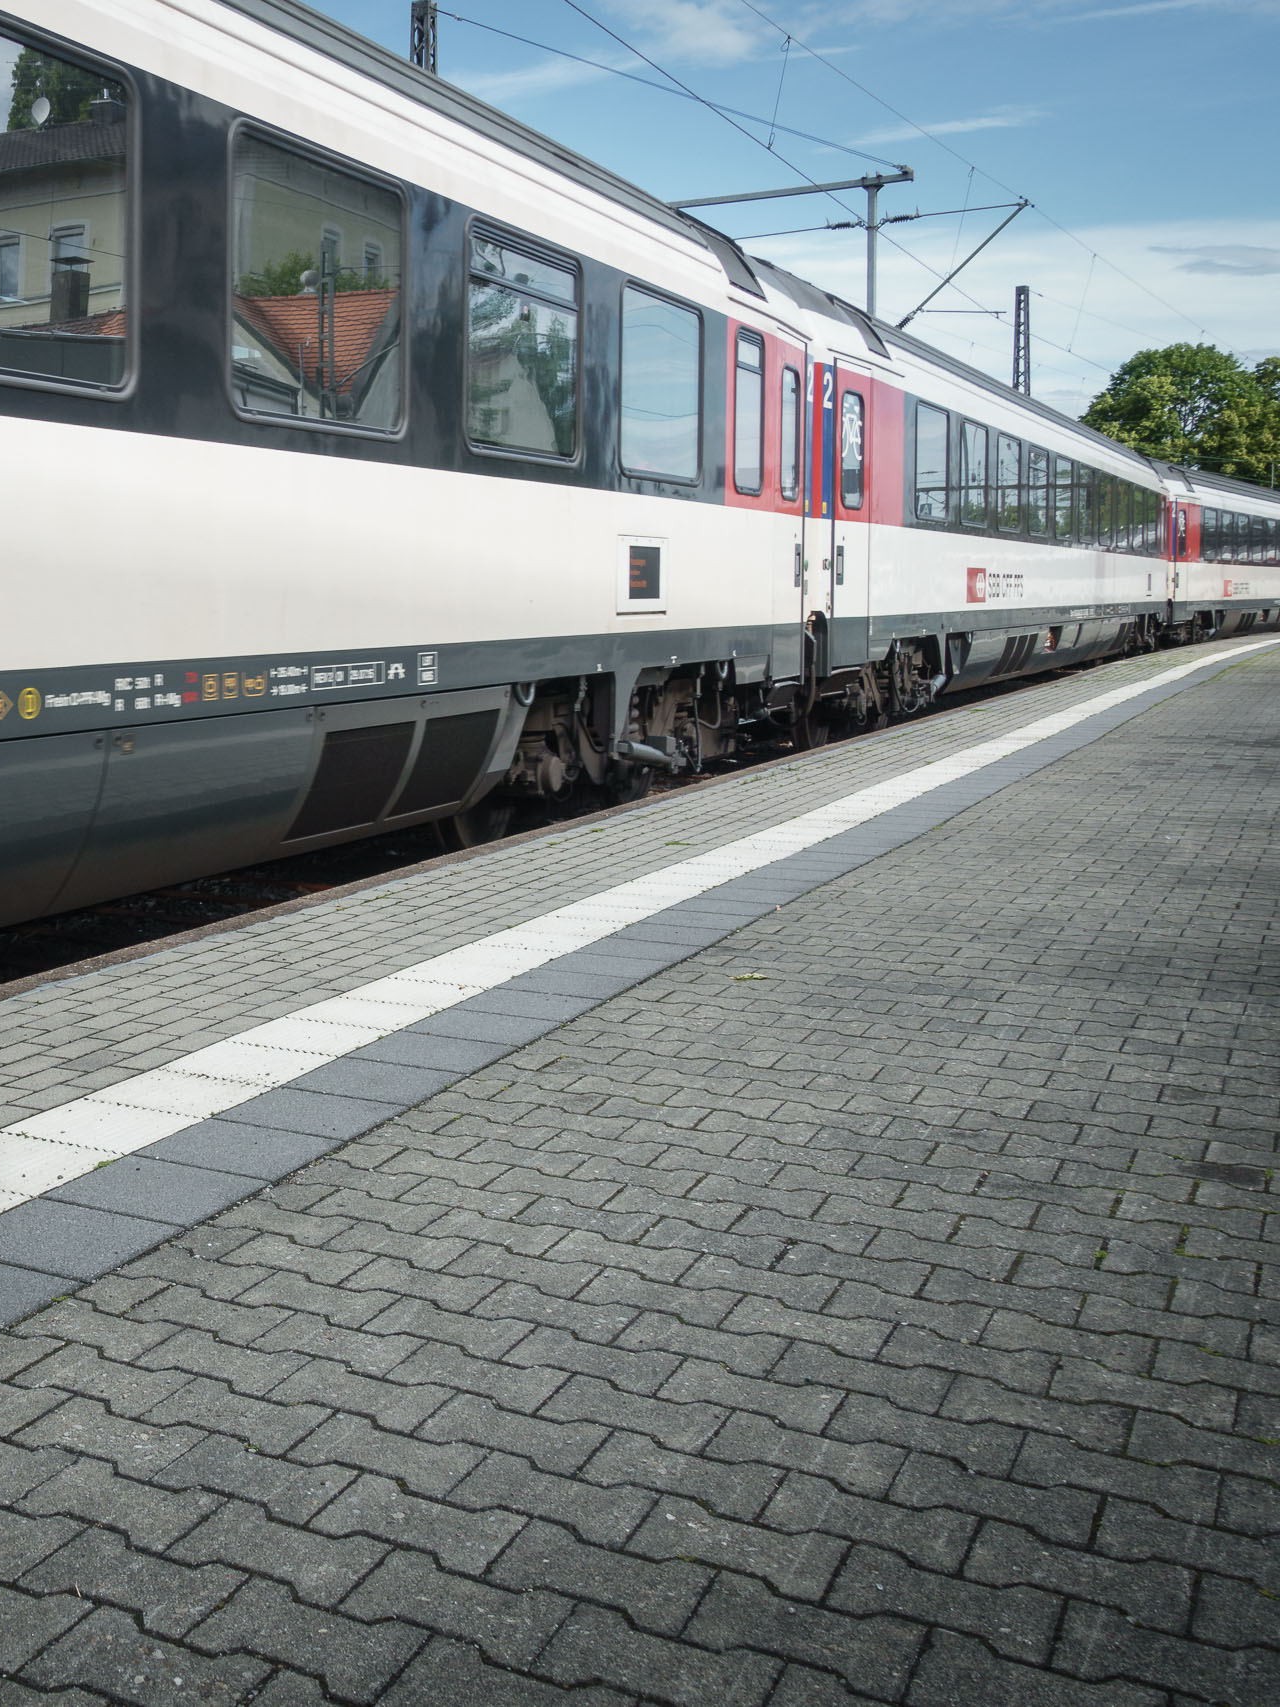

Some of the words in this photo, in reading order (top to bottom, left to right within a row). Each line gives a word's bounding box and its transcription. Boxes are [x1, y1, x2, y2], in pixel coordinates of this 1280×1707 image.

[806, 363, 814, 402] 2
[823, 371, 833, 409] 2
[988, 573, 1001, 598] SBB
[1002, 573, 1012, 598] CFF
